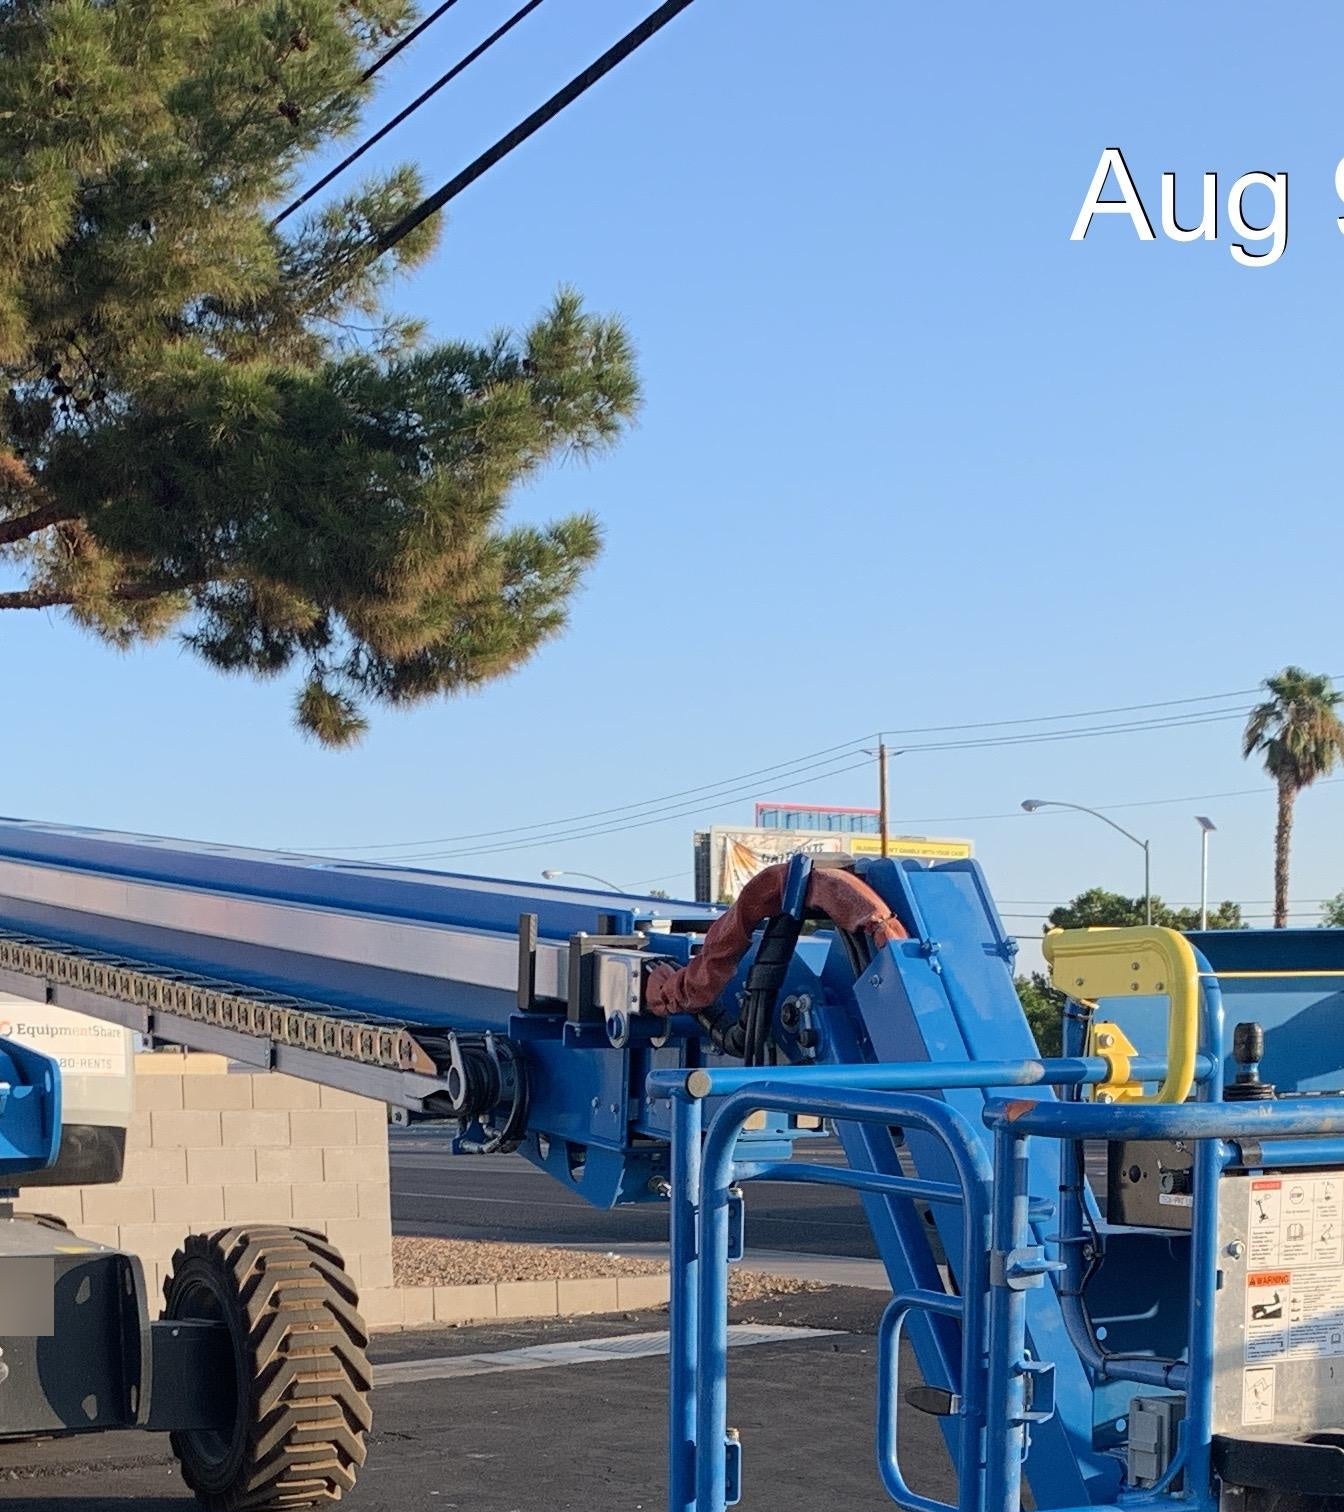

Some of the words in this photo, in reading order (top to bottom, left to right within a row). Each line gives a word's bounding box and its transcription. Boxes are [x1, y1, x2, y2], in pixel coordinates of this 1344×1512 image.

[16, 1023, 121, 1039] EquipmentShare
[60, 1057, 112, 1070] 80-RENTS
[1257, 1275, 1289, 1285] WARNING
